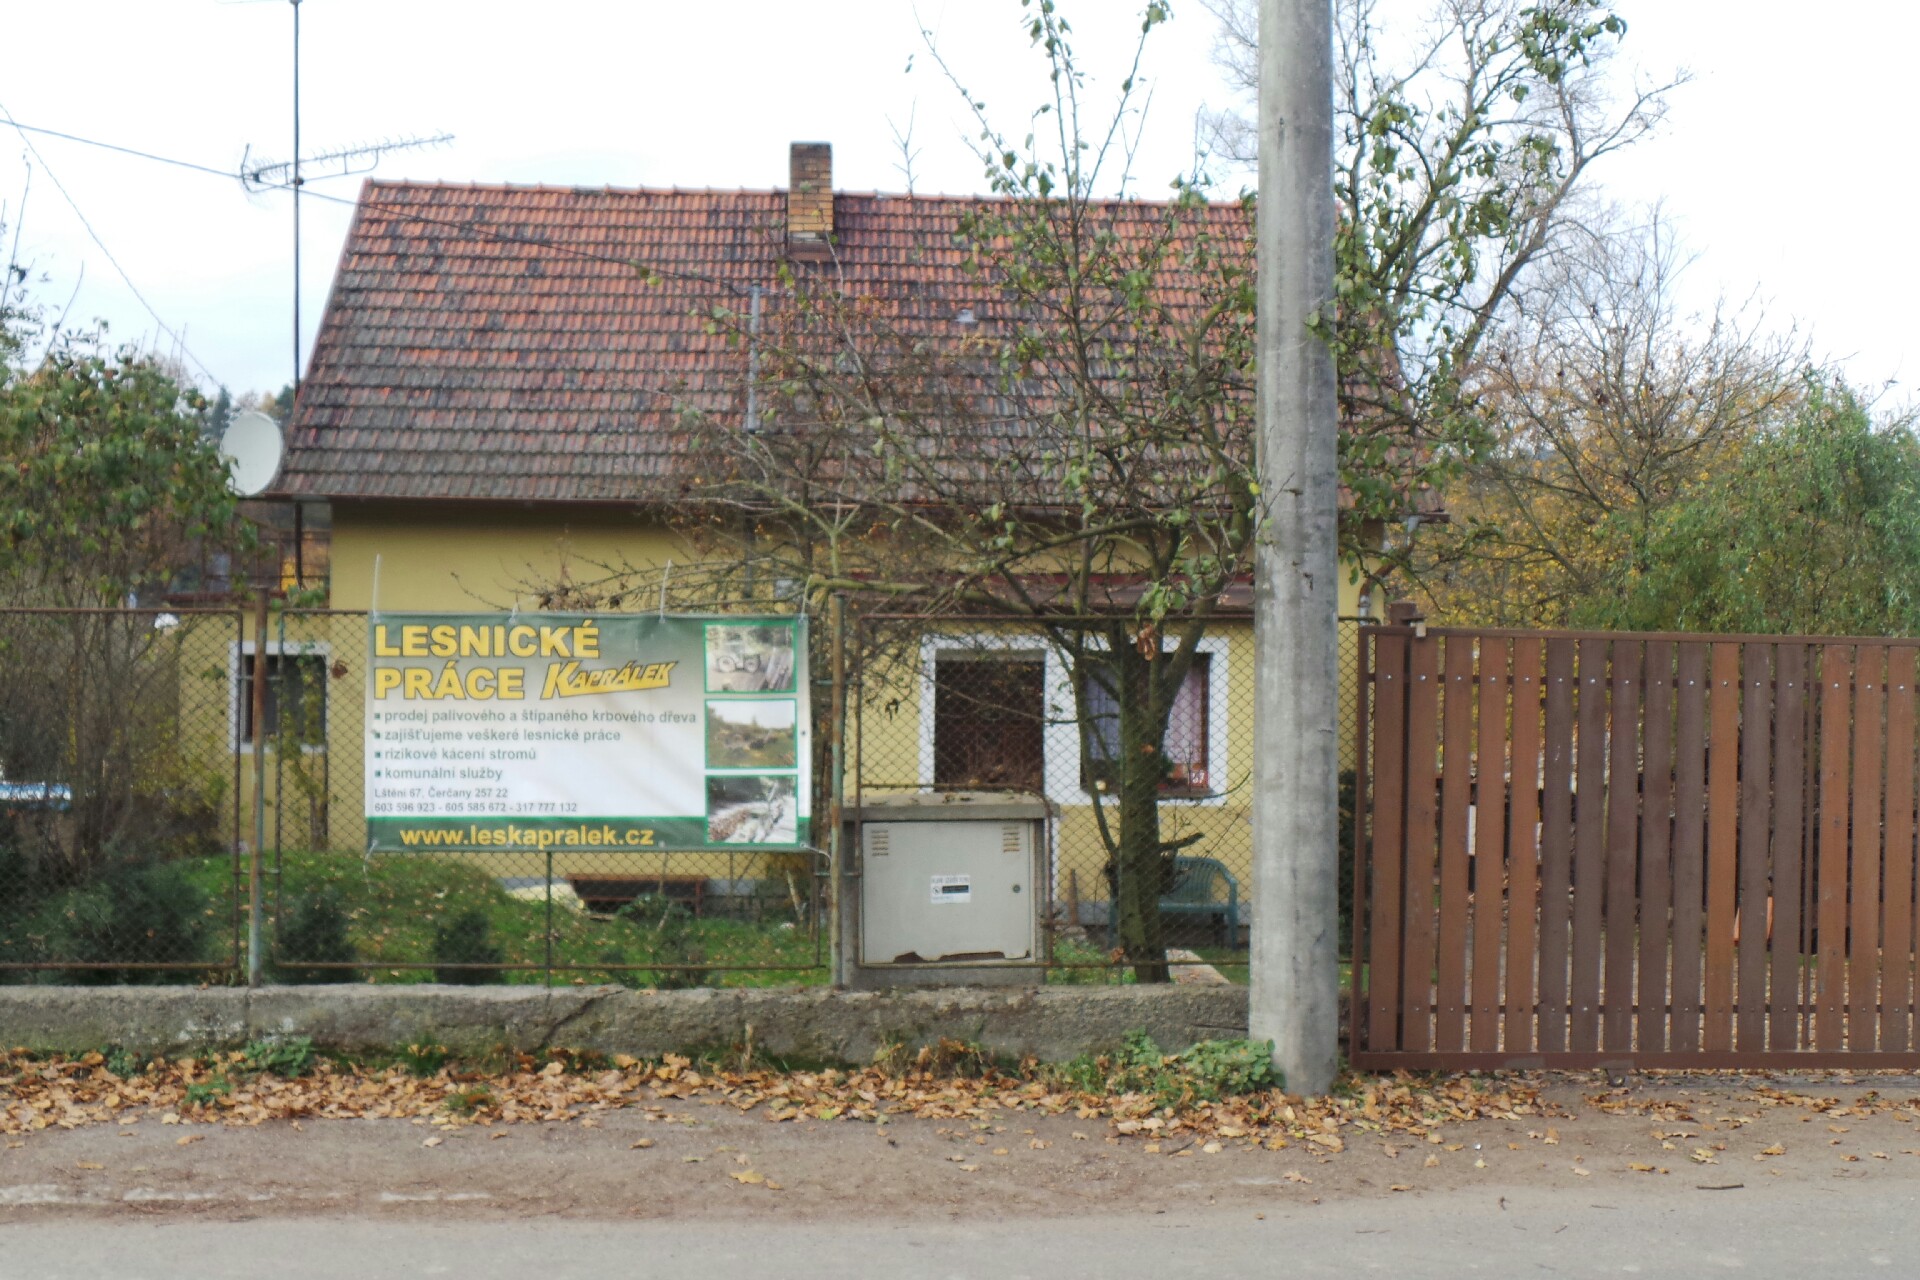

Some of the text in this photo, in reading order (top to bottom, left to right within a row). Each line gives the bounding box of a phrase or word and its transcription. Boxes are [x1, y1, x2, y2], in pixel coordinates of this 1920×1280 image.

[374, 618, 600, 659] LESNICKÉ
[374, 660, 525, 700] PRÁCE
[384, 709, 696, 725] prodej palivového a štípaného krbového dřeva
[384, 729, 621, 743] zajišťujeme veškeré lesnické práce
[384, 748, 537, 760] rizikové kácení stromů
[385, 767, 503, 781] komunální služby
[428, 787, 472, 799] Čerčany
[475, 788, 492, 798] 257
[495, 788, 508, 798] 22
[374, 803, 392, 812] 603
[395, 803, 414, 812] 596
[417, 803, 435, 812] 923
[445, 803, 463, 812] 605
[488, 803, 506, 812] 672
[516, 803, 534, 812] 317
[538, 803, 555, 812] 777
[560, 803, 577, 812] 132
[400, 825, 655, 850] www.leskapralek.cz
